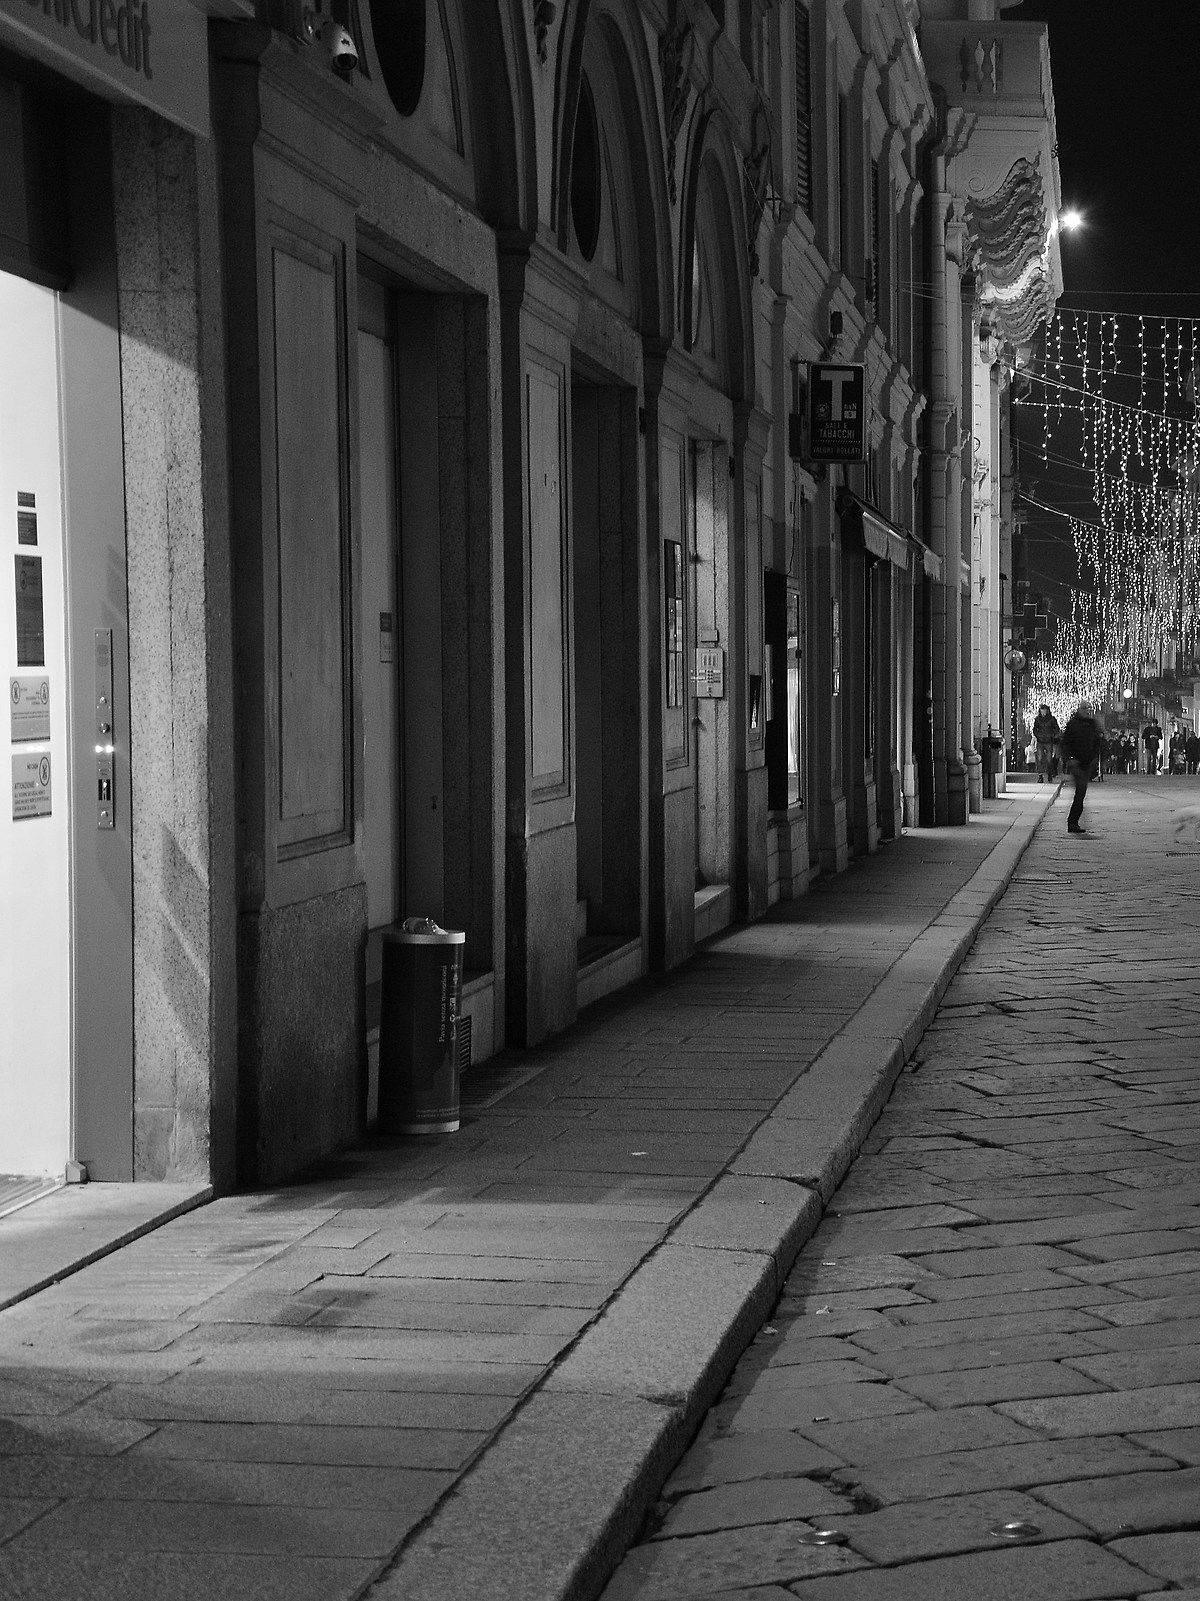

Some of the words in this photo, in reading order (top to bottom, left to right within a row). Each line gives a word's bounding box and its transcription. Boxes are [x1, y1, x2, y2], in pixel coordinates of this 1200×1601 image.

[820, 370, 854, 421] T
[819, 429, 855, 439] TABACCHI
[813, 446, 834, 454] VALORI
[836, 446, 861, 455] BOLLATI
